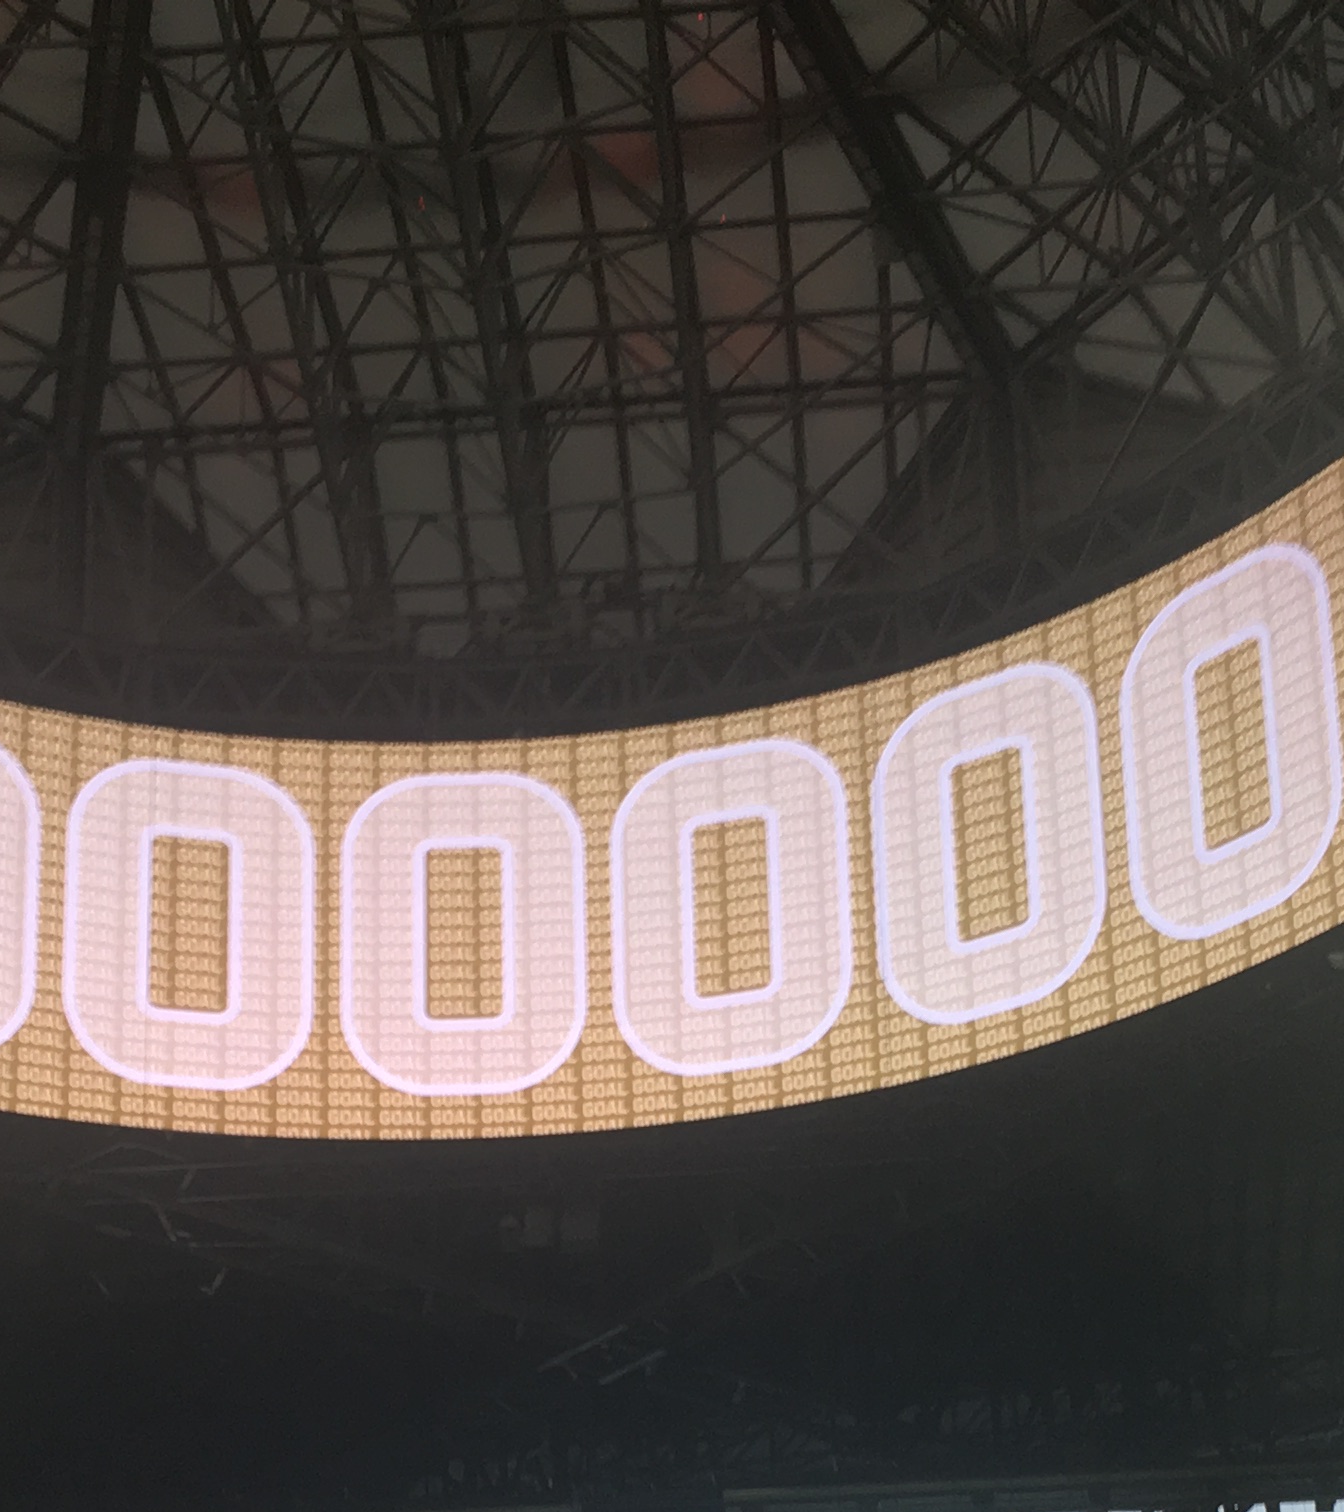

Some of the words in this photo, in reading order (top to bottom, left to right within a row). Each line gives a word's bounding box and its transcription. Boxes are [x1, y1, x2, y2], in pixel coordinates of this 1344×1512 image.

[582, 1045, 628, 1063] GOAL
[276, 1072, 320, 1089] GOAL
[327, 1073, 375, 1090] GOAL
[582, 1064, 628, 1081] GOAL
[582, 1082, 628, 1099] GOAL
[633, 1075, 678, 1093] GOAL
[276, 1090, 323, 1107] GOAL
[327, 1090, 374, 1108] GOAL
[532, 1086, 578, 1102] GOAL
[683, 1088, 730, 1106] GOAL
[172, 1101, 219, 1119] GOAL
[532, 1104, 579, 1121] GOAL
[583, 1100, 630, 1118] GOAL
[633, 1095, 680, 1112] GOAL
[224, 1104, 272, 1123] GOAL
[276, 1108, 323, 1125] GOAL
[327, 1108, 376, 1126] GOAL
[379, 1108, 426, 1126] GOAL
[430, 1107, 477, 1125] GOAL
[481, 1105, 528, 1123] GOAL
